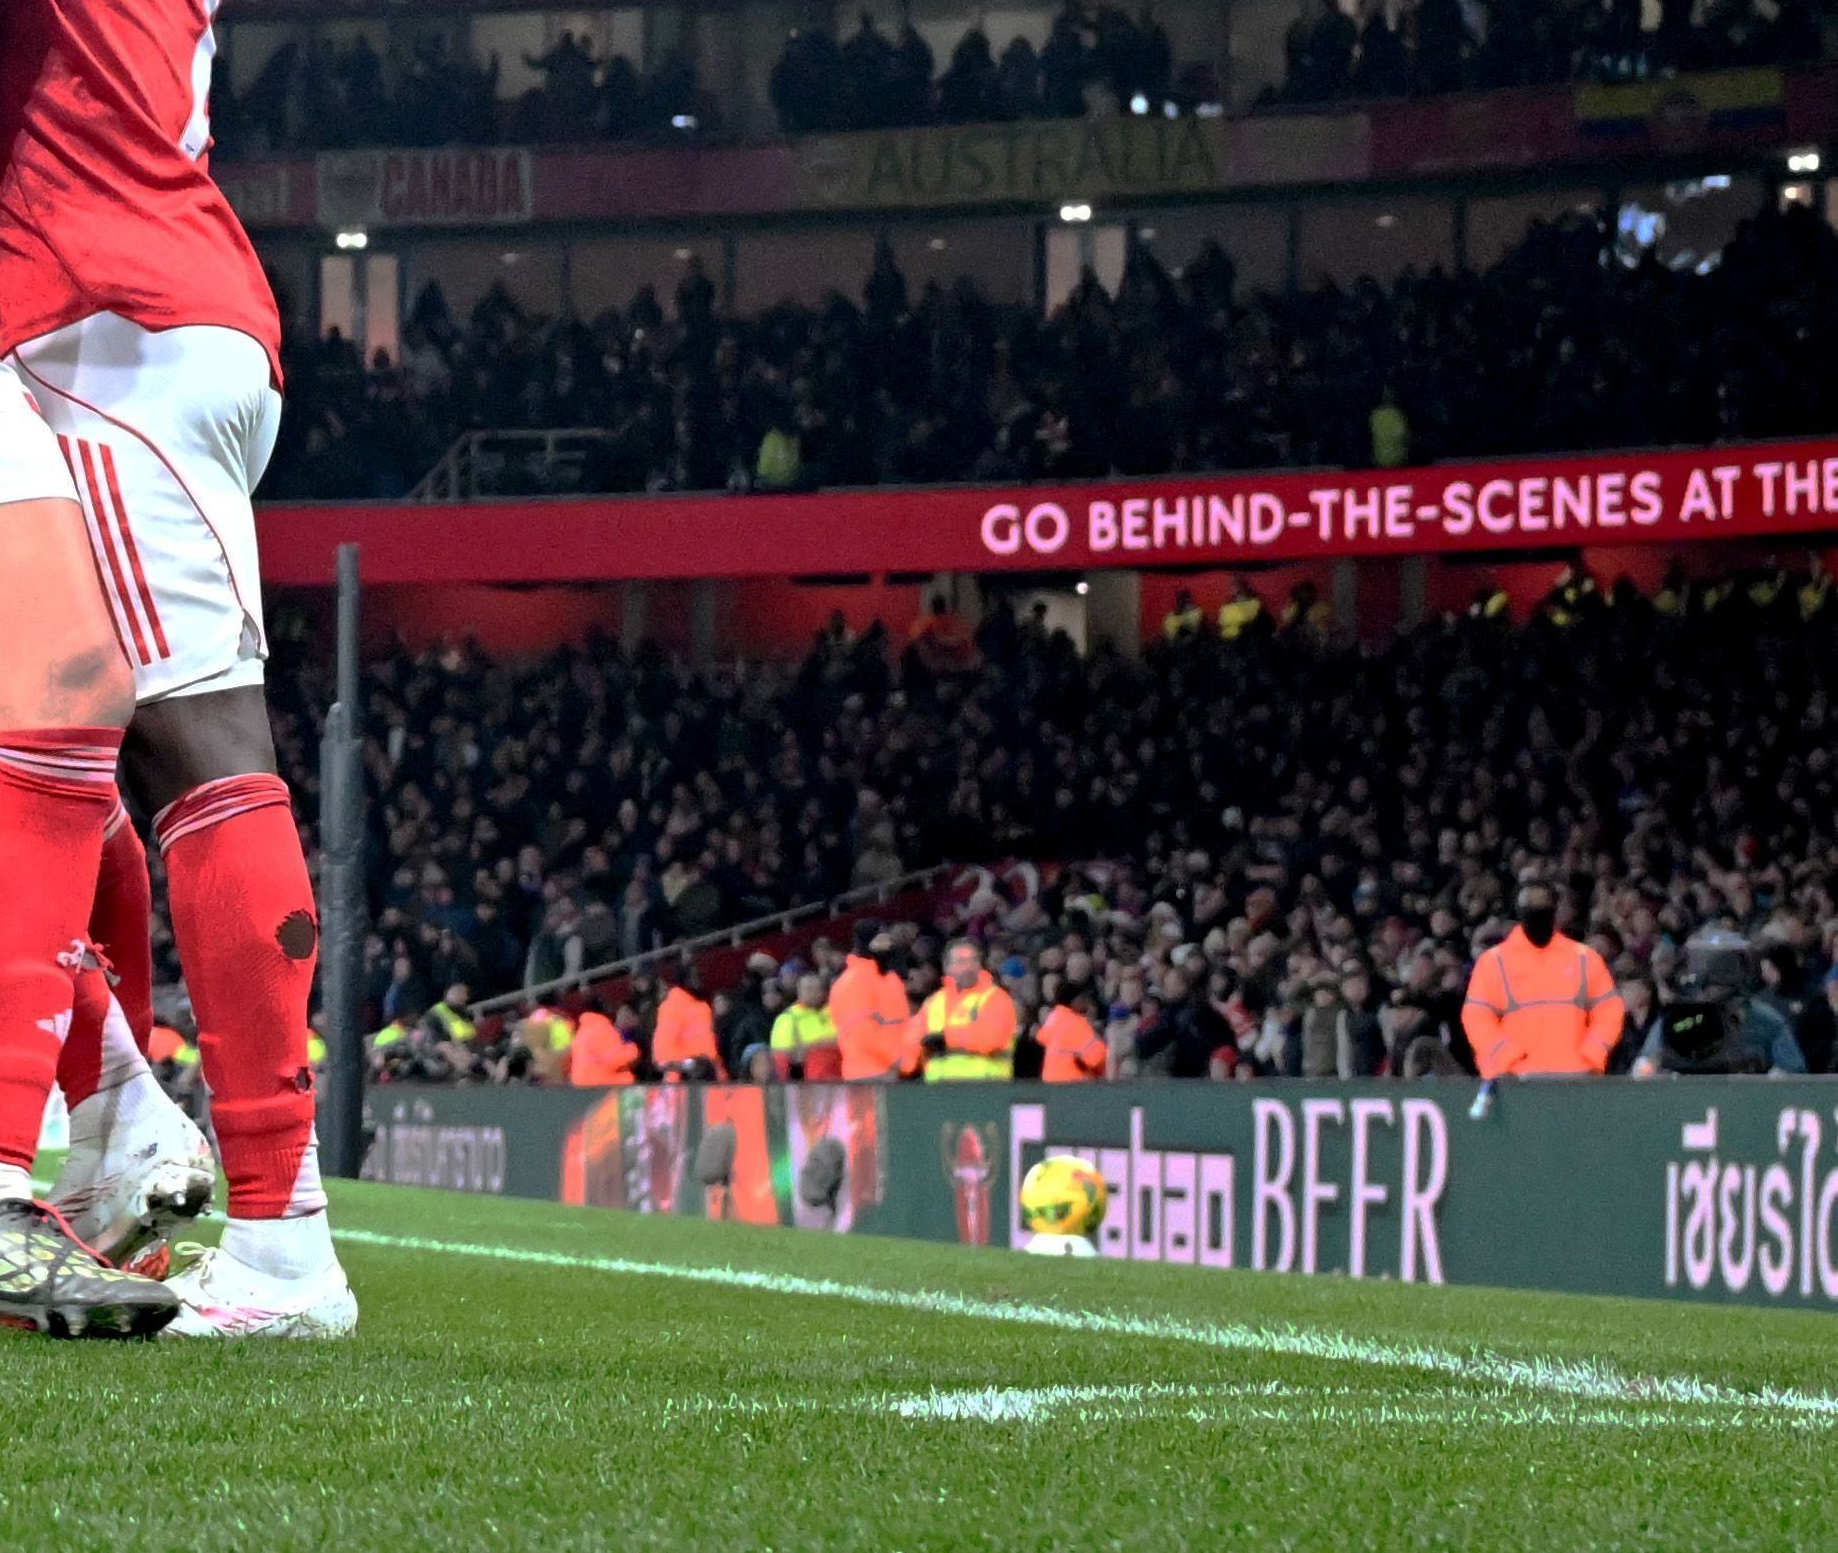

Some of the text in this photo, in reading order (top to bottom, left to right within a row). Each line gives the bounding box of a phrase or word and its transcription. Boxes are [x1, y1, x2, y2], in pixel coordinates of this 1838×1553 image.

[868, 117, 1218, 194] AUSTRALIA
[980, 457, 1838, 554] GO BEHIND-THE-SCENES AT THE
[1251, 1097, 1450, 1286] BEER
